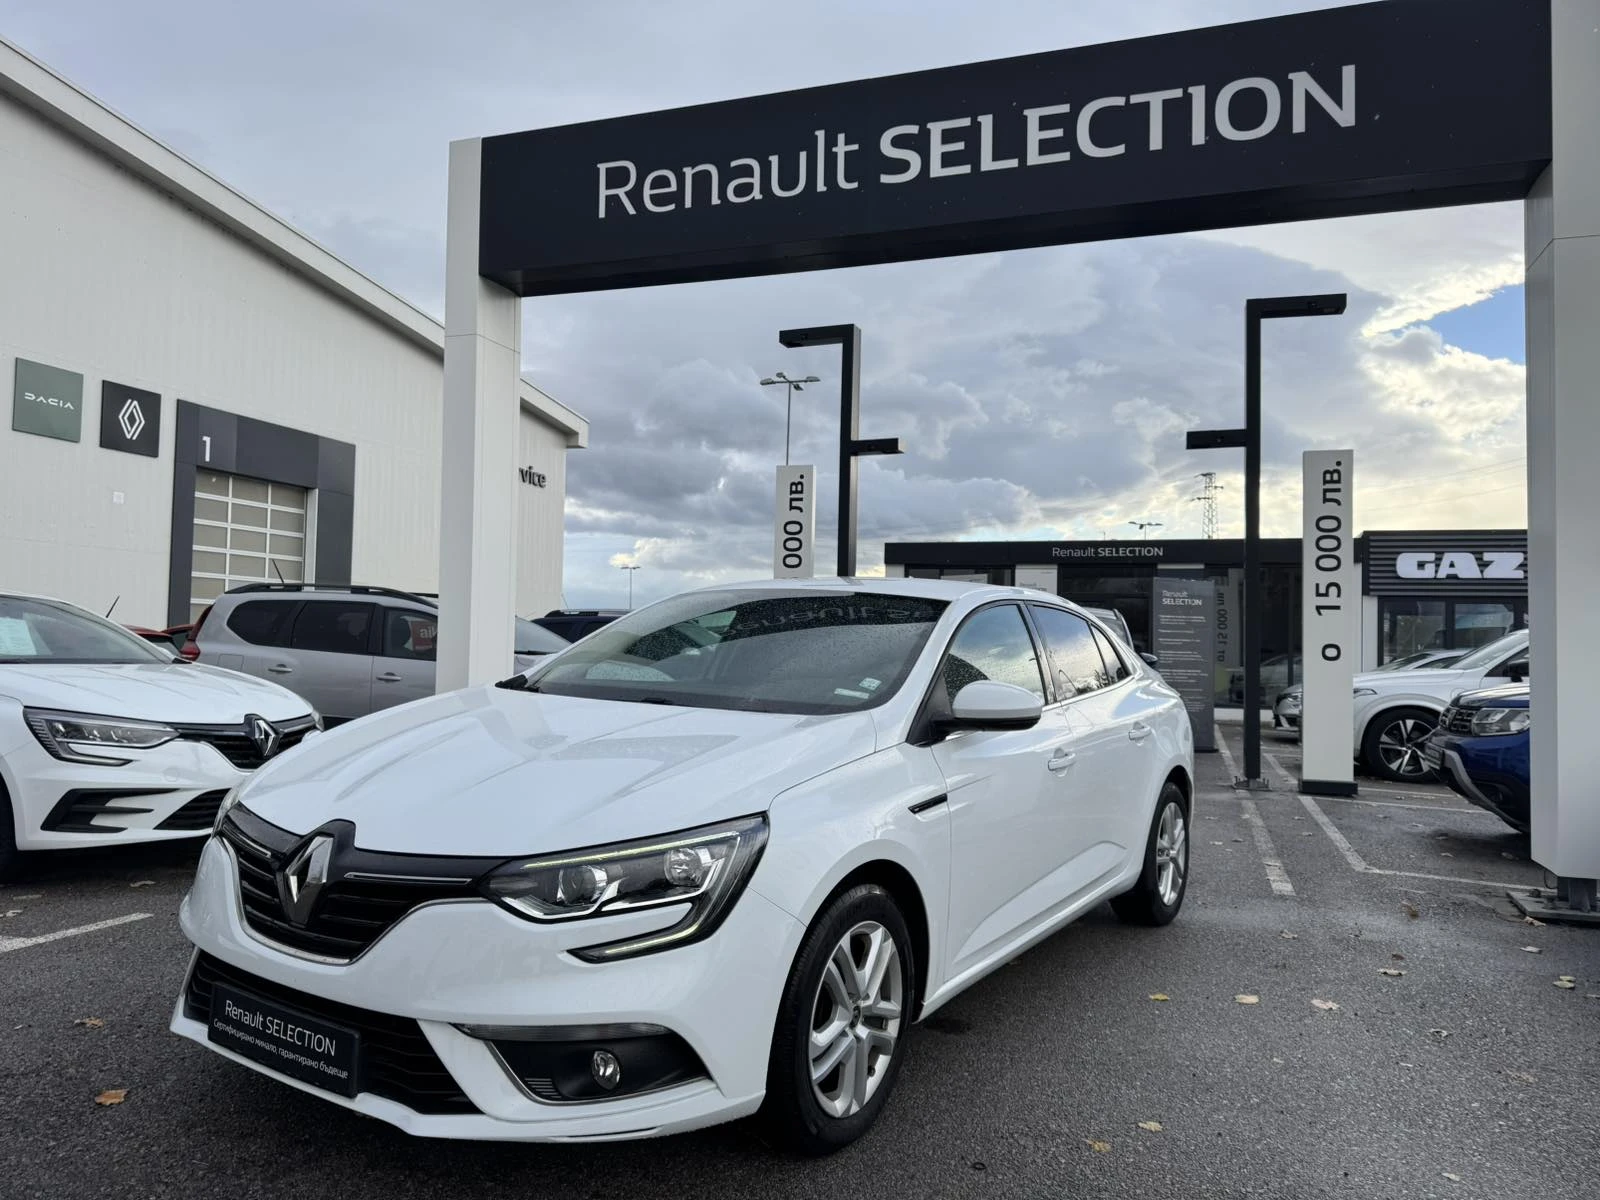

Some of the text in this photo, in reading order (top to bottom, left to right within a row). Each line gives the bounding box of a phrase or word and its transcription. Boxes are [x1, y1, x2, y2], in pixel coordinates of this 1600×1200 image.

[595, 64, 1358, 219] Renault SELECTION
[24, 392, 75, 410] DACIA
[201, 435, 212, 463] 1
[1322, 460, 1342, 506] лв.
[782, 474, 805, 569] 000 лв.
[1052, 547, 1164, 558] Renault SELECTION
[1315, 515, 1342, 572] 000
[1396, 552, 1524, 579] GAZ
[1161, 598, 1203, 606] SELECTION
[1315, 581, 1342, 616] 15
[225, 1000, 336, 1057] Renault SELECTION
[213, 1018, 255, 1044] Сертифицирано
[278, 1048, 319, 1070] гарантирано
[319, 1061, 349, 1080] бъдеще
